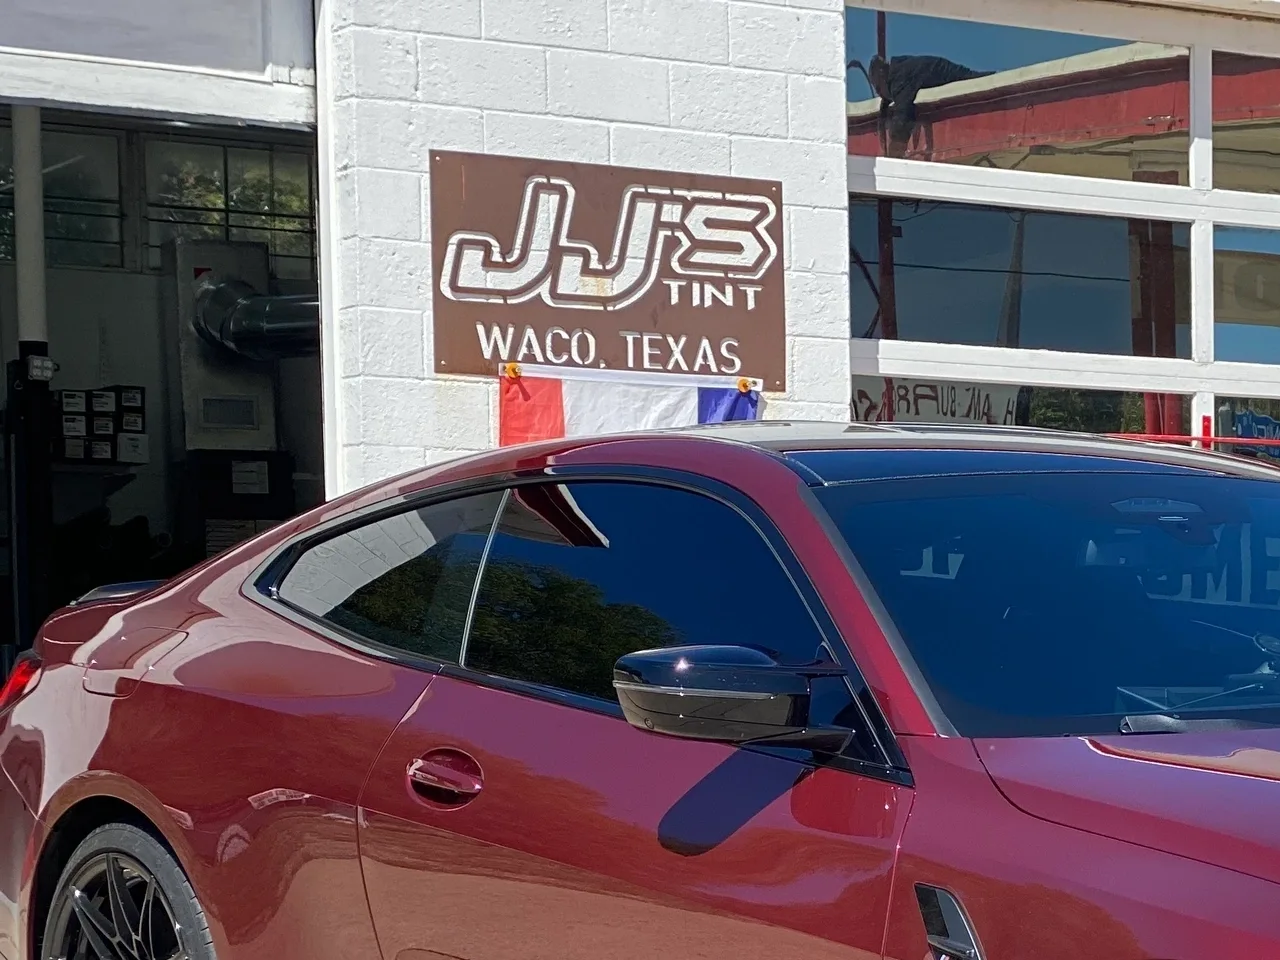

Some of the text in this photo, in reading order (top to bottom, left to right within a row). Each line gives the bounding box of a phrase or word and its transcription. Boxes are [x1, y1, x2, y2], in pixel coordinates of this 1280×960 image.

[439, 175, 777, 312] JJ'S
[662, 278, 763, 312] TINT
[619, 330, 742, 374] TEXAS
